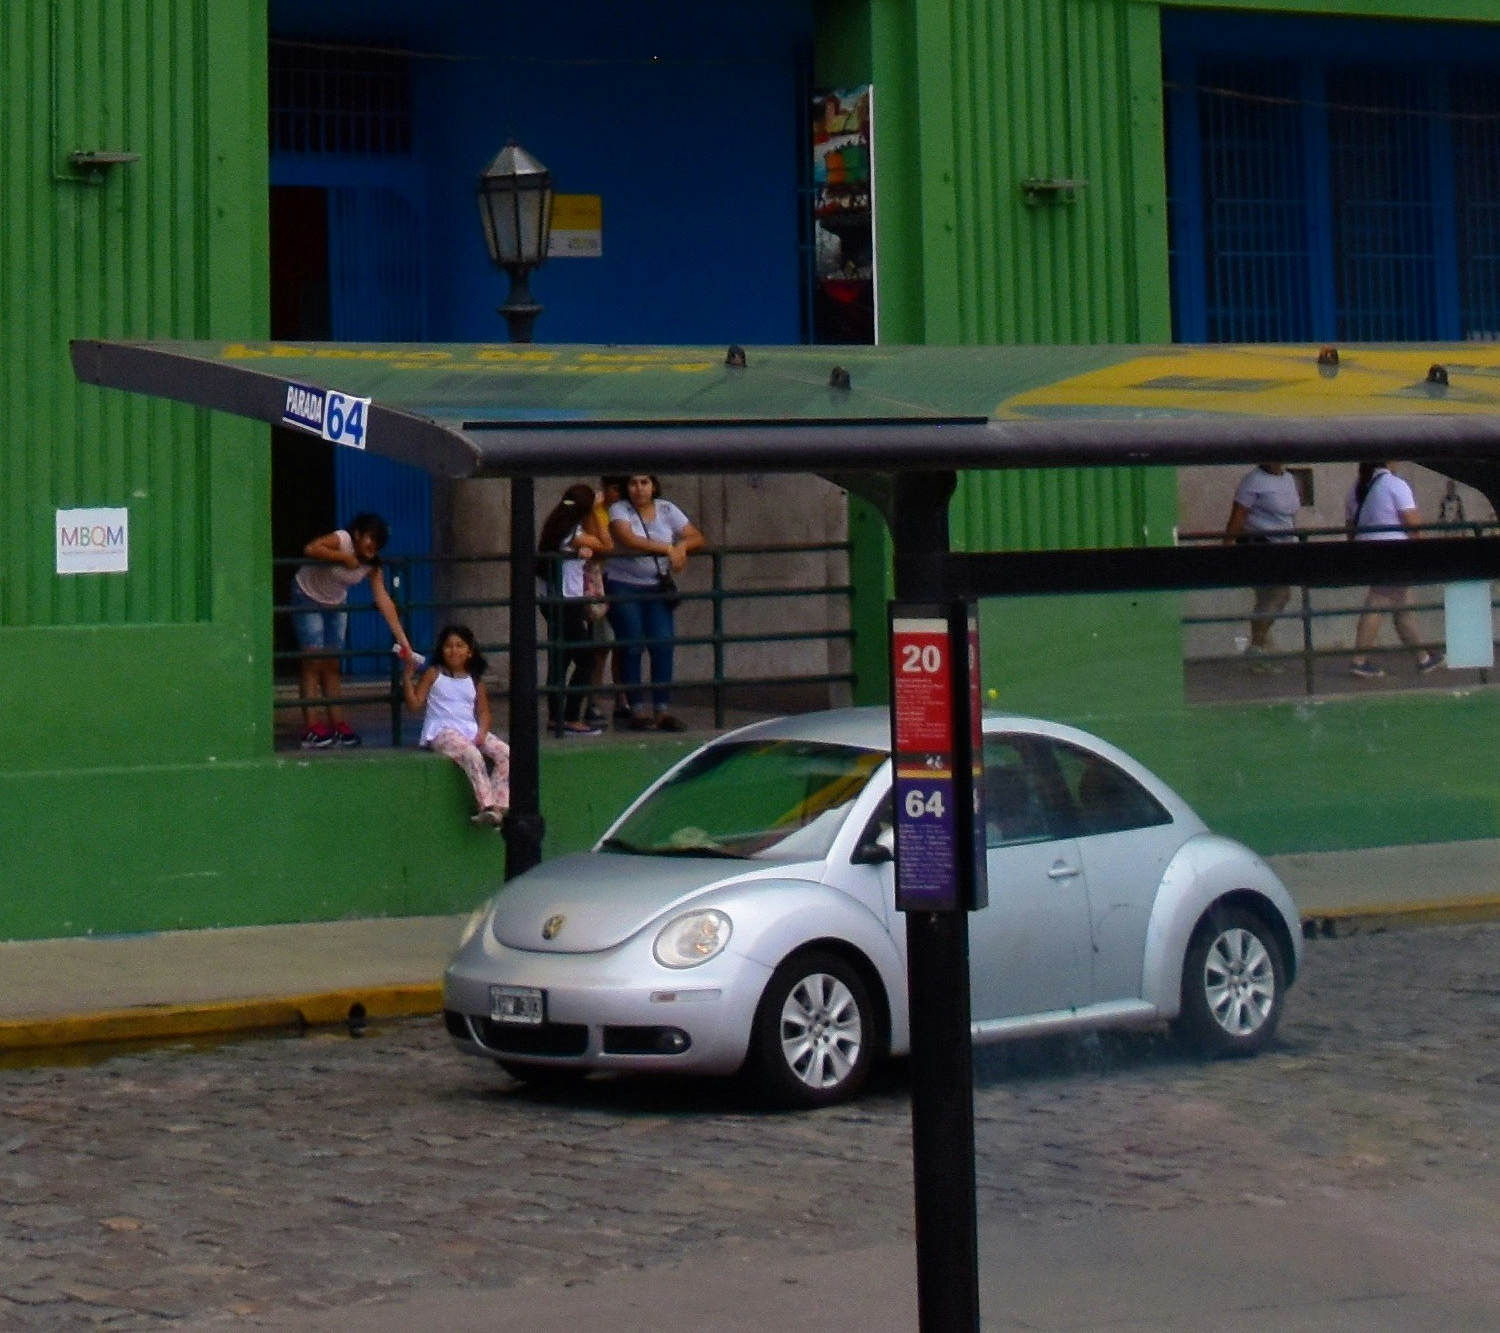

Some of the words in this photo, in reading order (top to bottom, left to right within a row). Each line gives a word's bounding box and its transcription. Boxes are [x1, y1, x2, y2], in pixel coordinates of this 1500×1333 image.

[286, 385, 323, 423] PARADA
[327, 394, 364, 445] 64
[61, 526, 124, 547] MBQM
[902, 644, 941, 673] 20
[905, 789, 945, 818] 64
